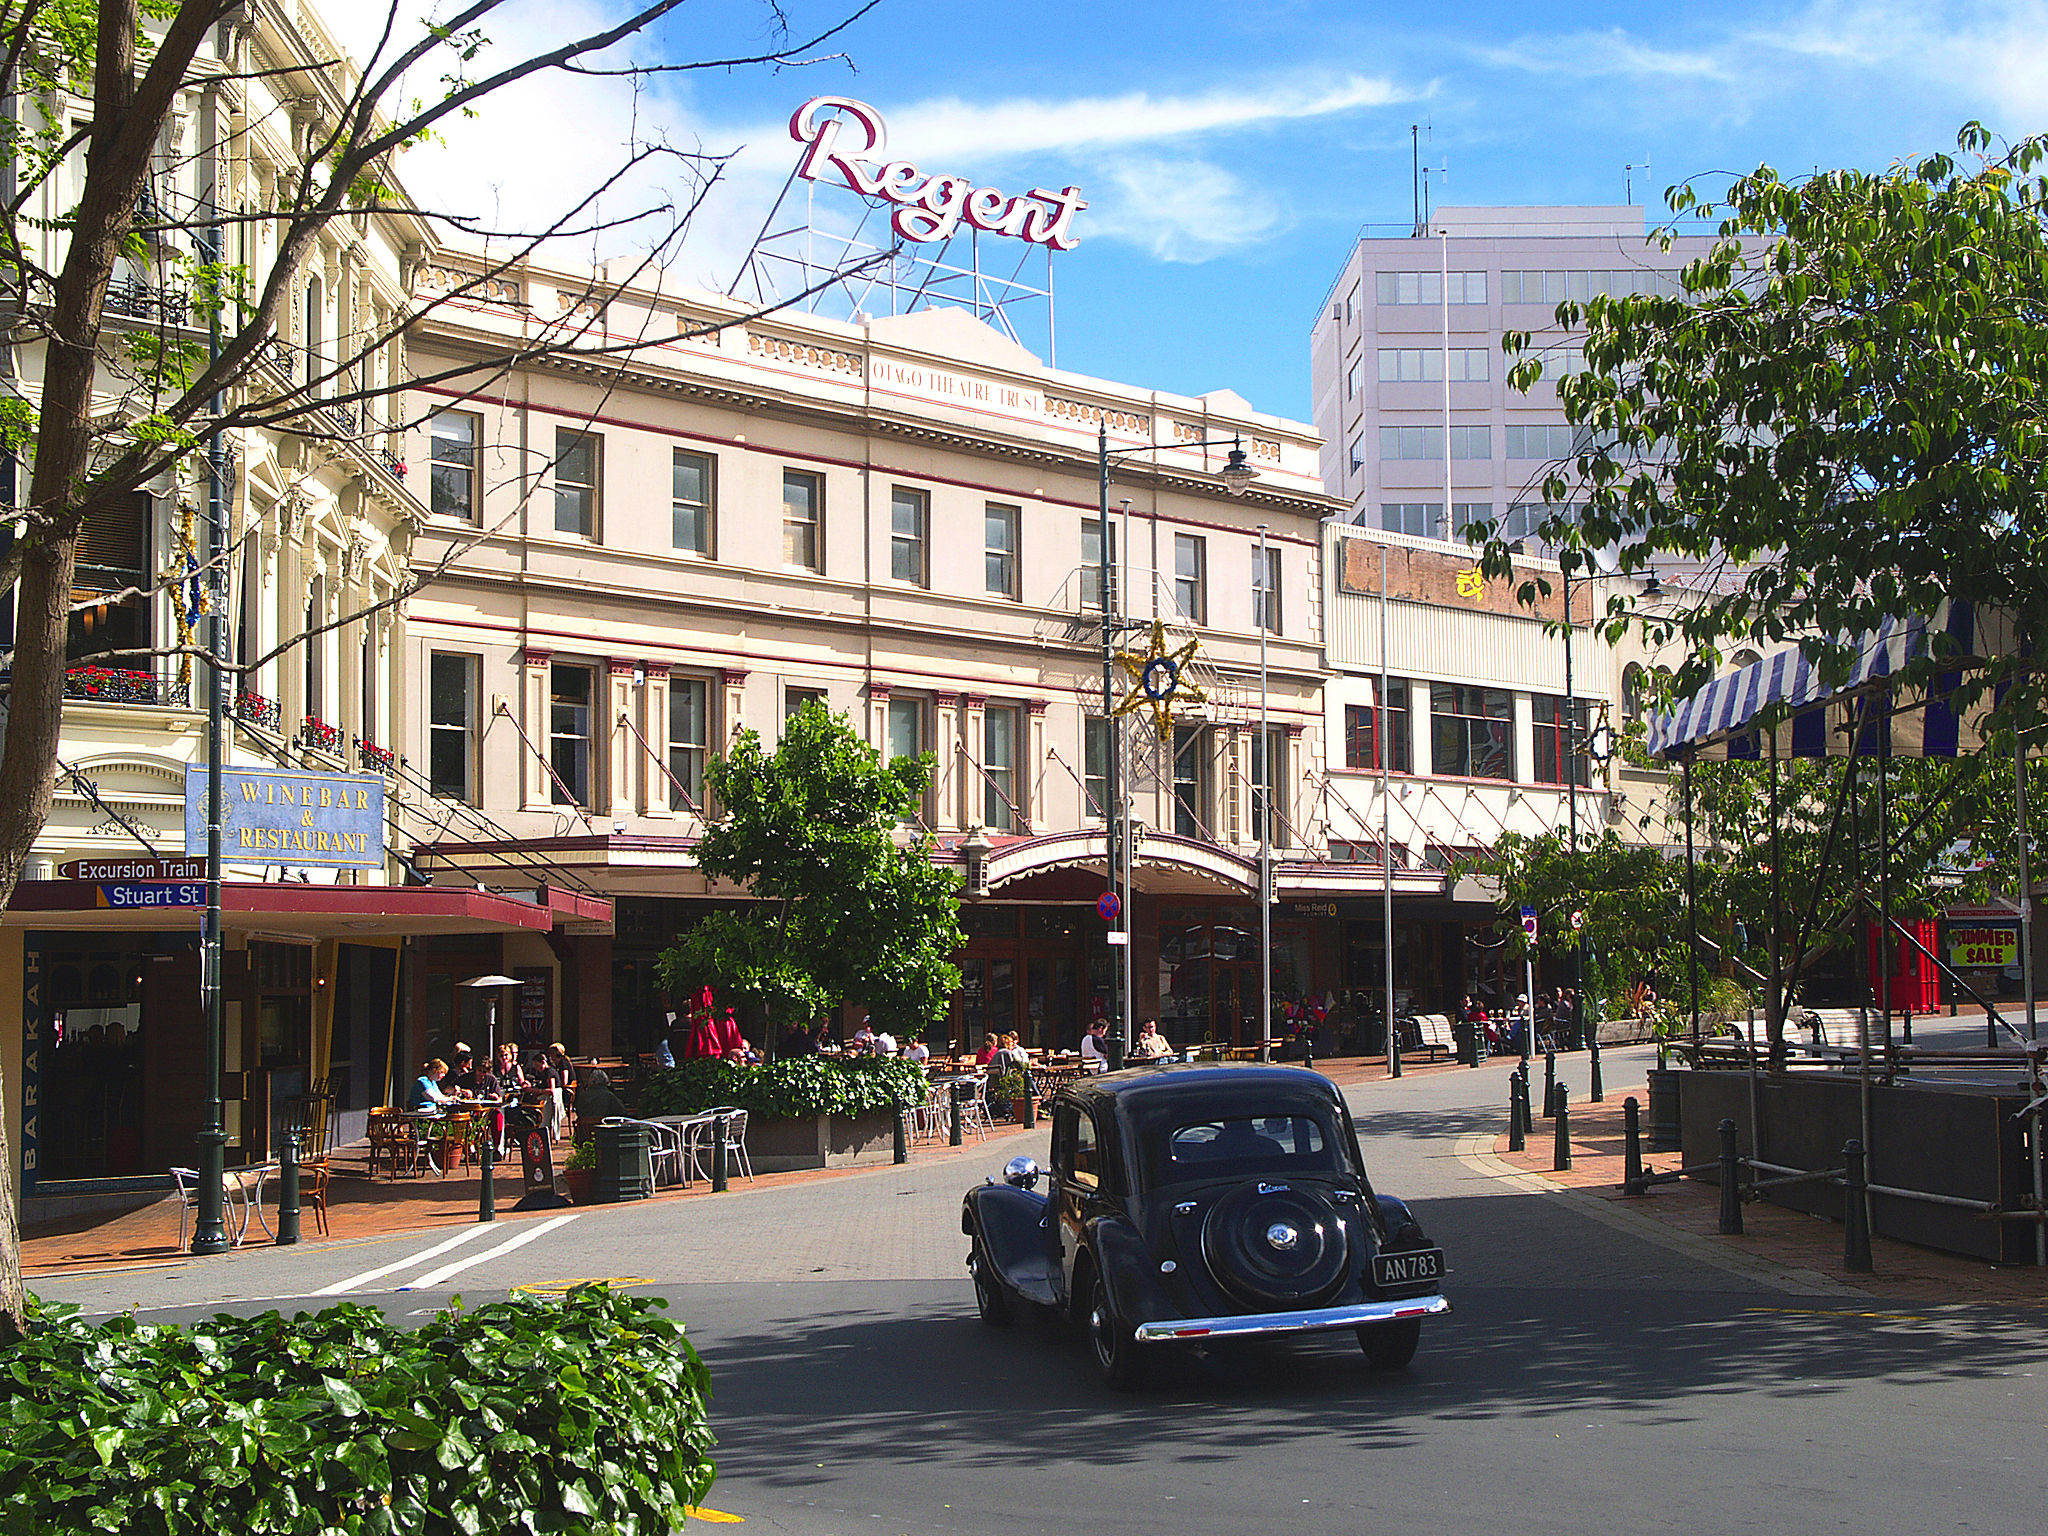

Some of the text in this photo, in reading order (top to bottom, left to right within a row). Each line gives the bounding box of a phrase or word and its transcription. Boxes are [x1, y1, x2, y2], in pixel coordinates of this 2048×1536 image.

[789, 95, 1089, 252] Regent
[873, 362, 1038, 412] OTAGO THEATRE TRUST
[301, 809, 315, 827] &
[239, 827, 369, 853] RESTAURANT
[78, 859, 199, 879] Excursion Train
[113, 885, 199, 905] Stuart St
[1966, 947, 2004, 964] SALE
[24, 951, 40, 1171] BARAKAH
